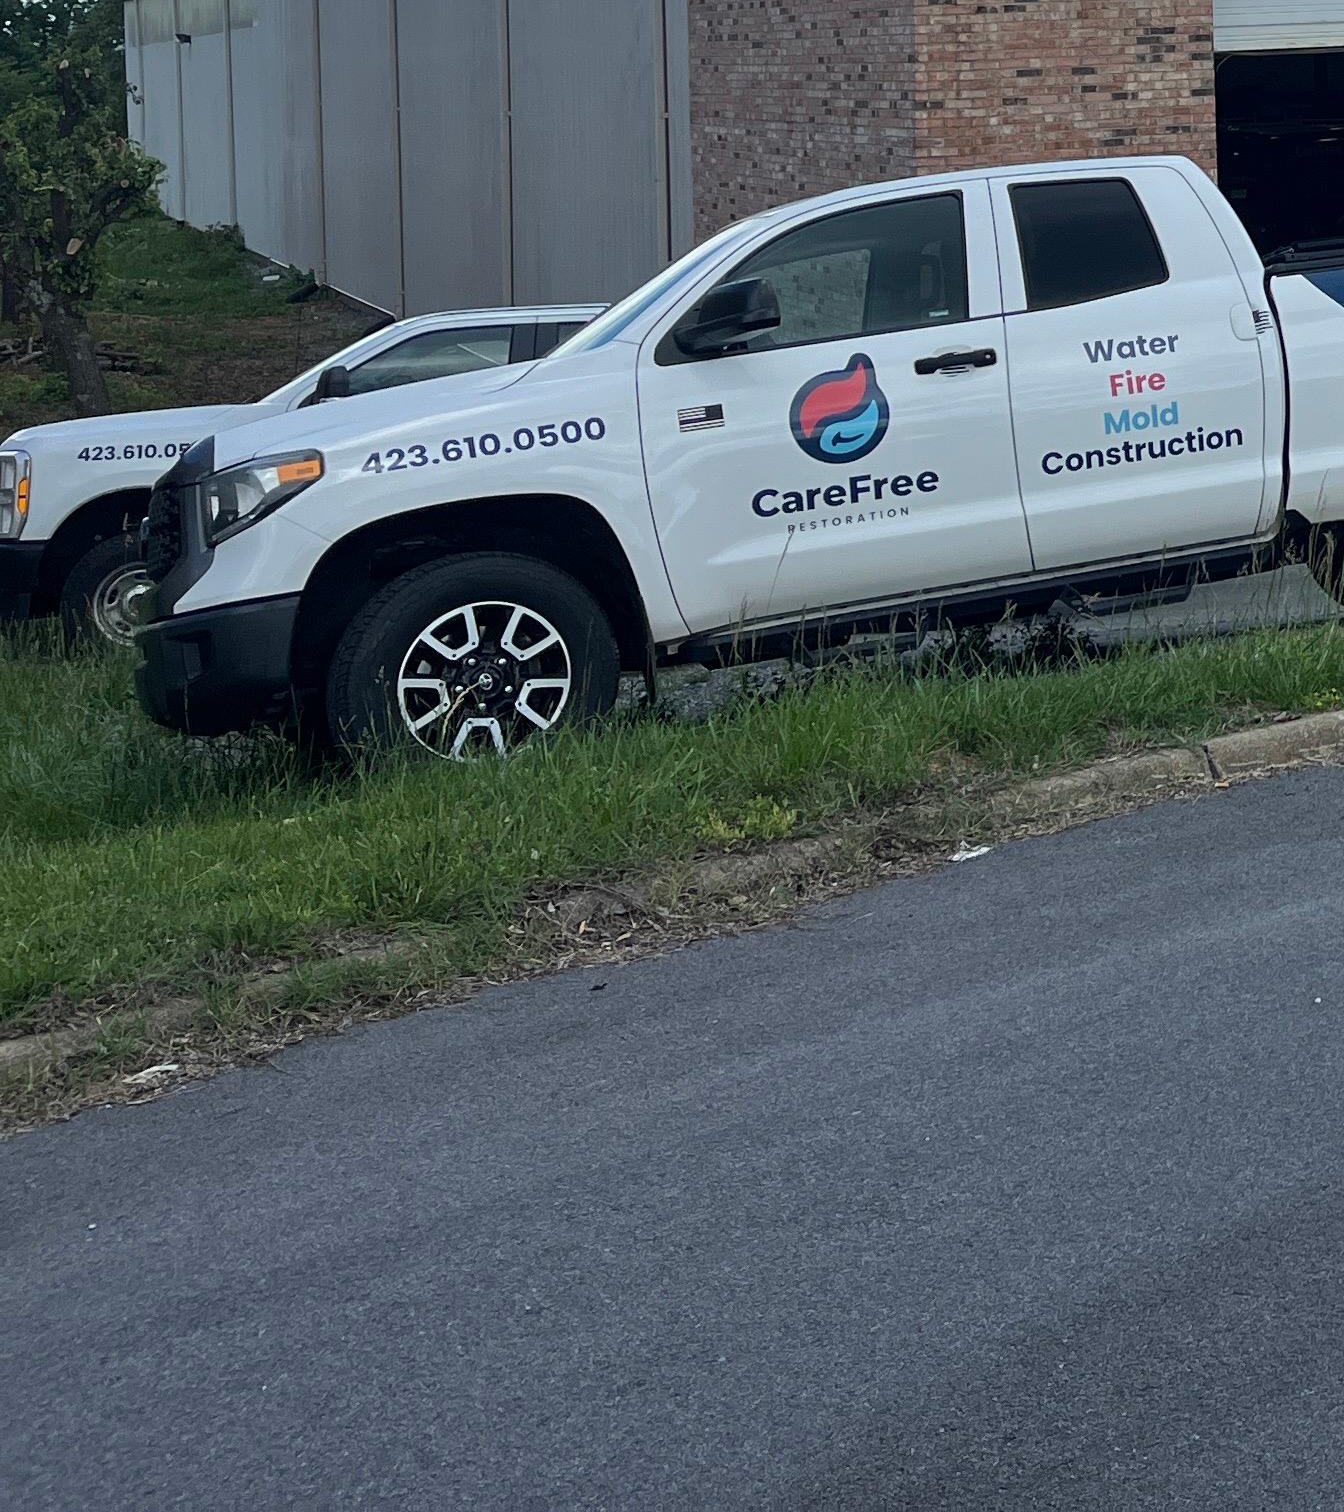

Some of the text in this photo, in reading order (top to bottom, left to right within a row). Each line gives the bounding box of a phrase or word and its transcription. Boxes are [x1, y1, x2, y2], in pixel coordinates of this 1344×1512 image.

[1082, 334, 1179, 364] Water
[1109, 369, 1166, 397] Fire
[1103, 401, 1179, 435] Mold
[361, 417, 606, 474] 423.610.0500
[1041, 426, 1243, 475] Construction
[752, 471, 939, 518] CareFree
[788, 507, 910, 534] RESTORATION
